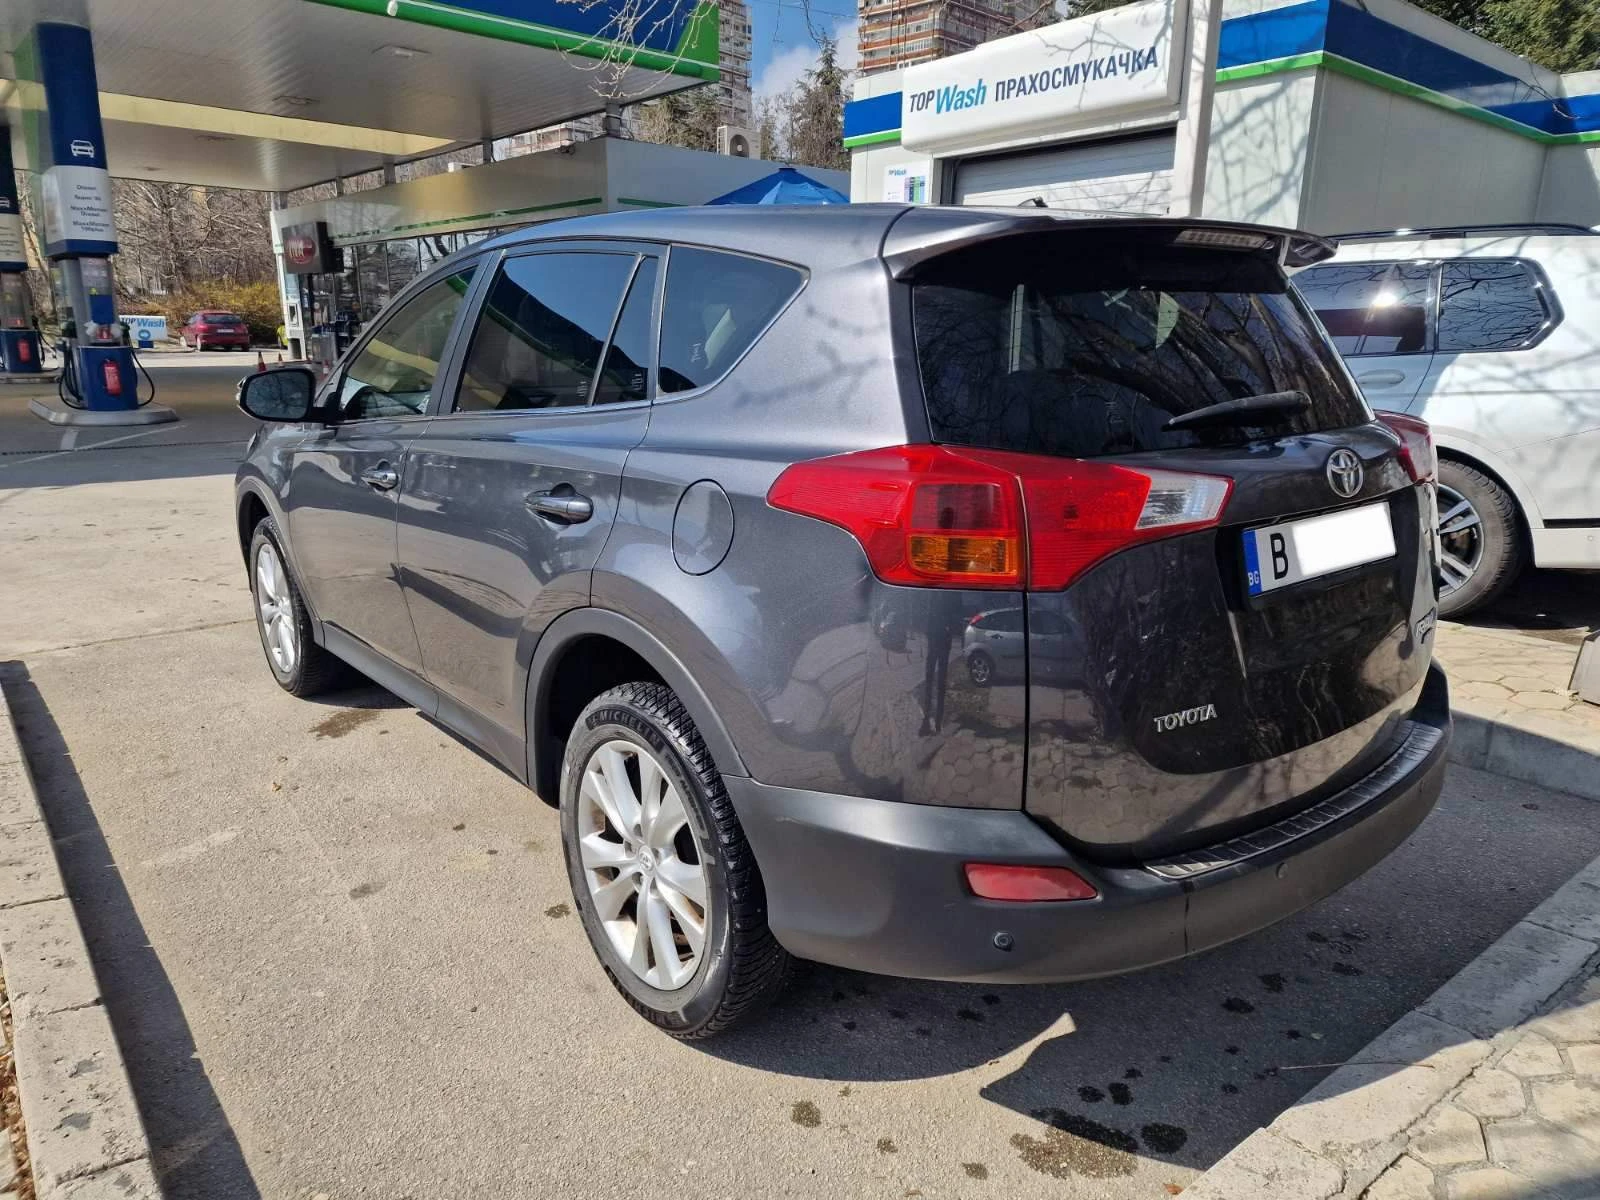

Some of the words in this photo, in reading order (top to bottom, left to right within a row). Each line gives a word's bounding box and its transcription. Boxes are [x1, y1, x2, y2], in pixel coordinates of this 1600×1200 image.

[995, 46, 1158, 102] ПРАХОСМУКАЧКА
[1269, 532, 1289, 581] B
[1248, 571, 1261, 586] BG
[1153, 703, 1218, 732] TOYOTA
